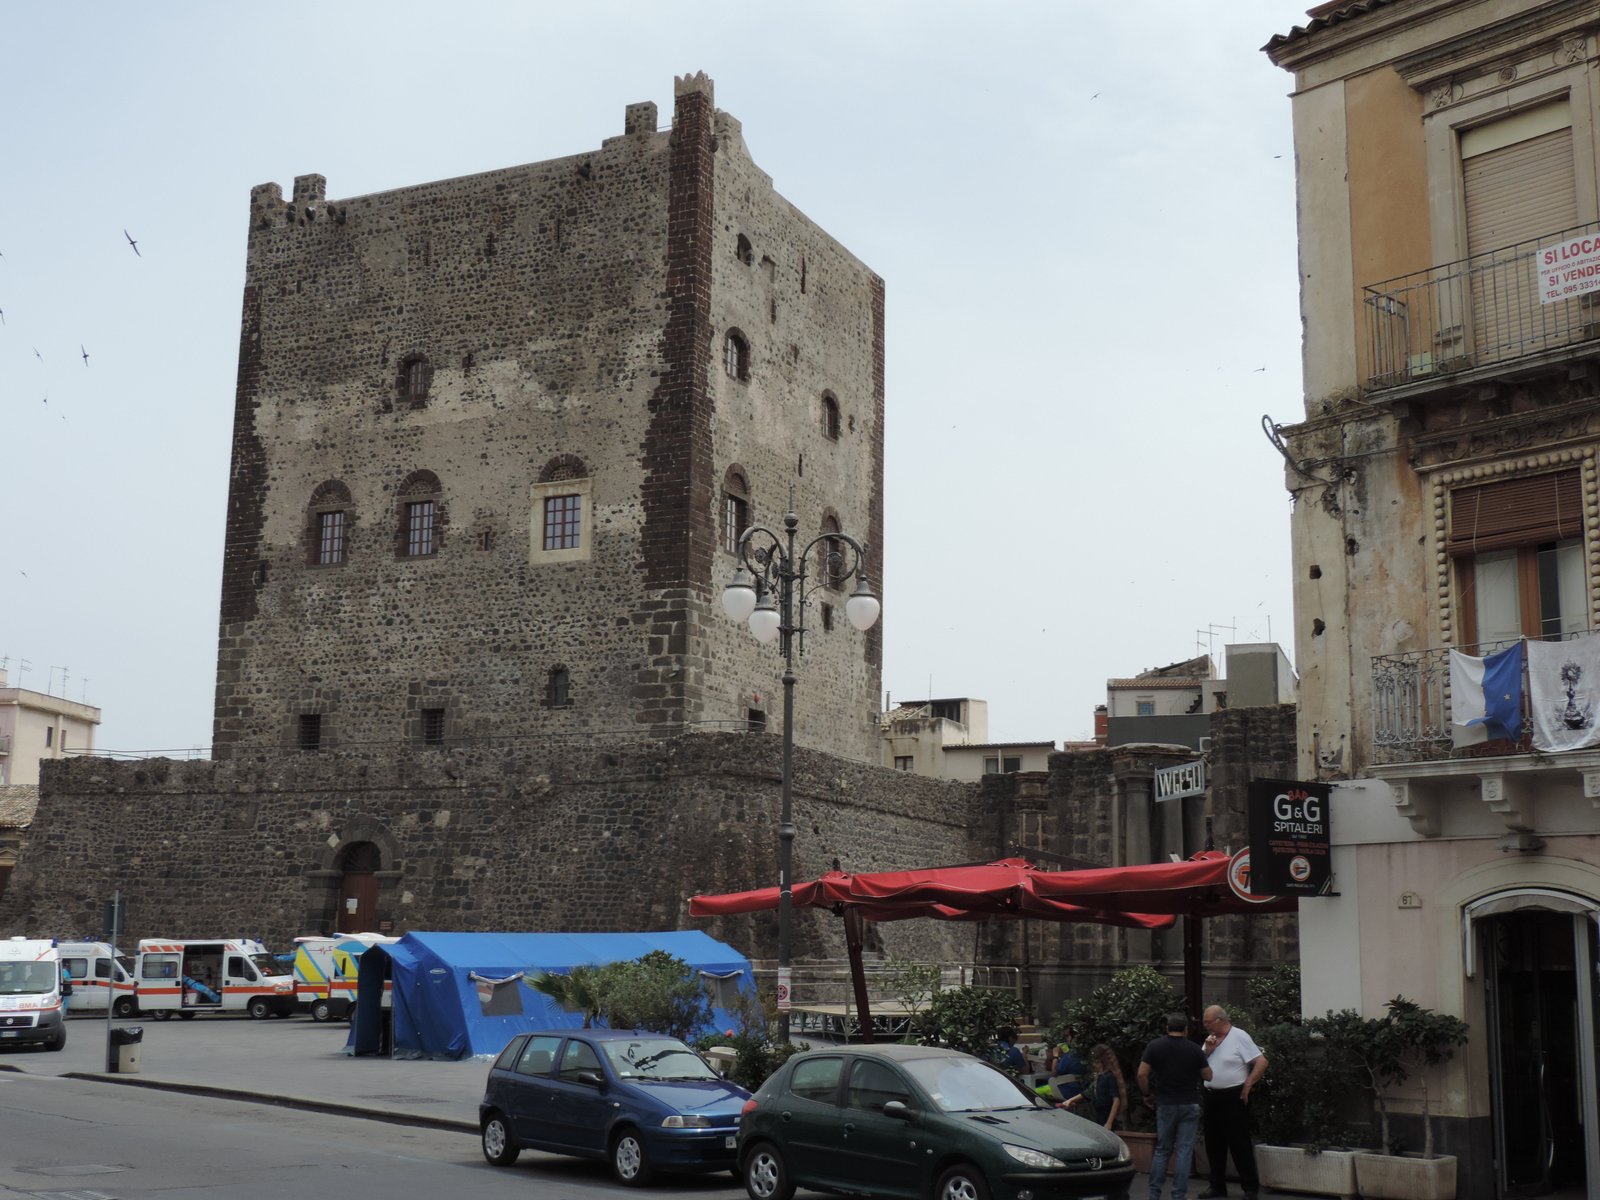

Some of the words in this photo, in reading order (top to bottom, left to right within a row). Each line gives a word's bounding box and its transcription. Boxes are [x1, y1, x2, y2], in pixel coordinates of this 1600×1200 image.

[1545, 250, 1558, 265] SI
[1562, 238, 1600, 260] LOCA
[1549, 275, 1559, 286] SI
[1563, 263, 1600, 282] VENDE
[1547, 290, 1562, 298] TEL.
[1564, 285, 1577, 294] 095
[1287, 789, 1309, 801] BAR
[1273, 821, 1323, 835] SPITALERI
